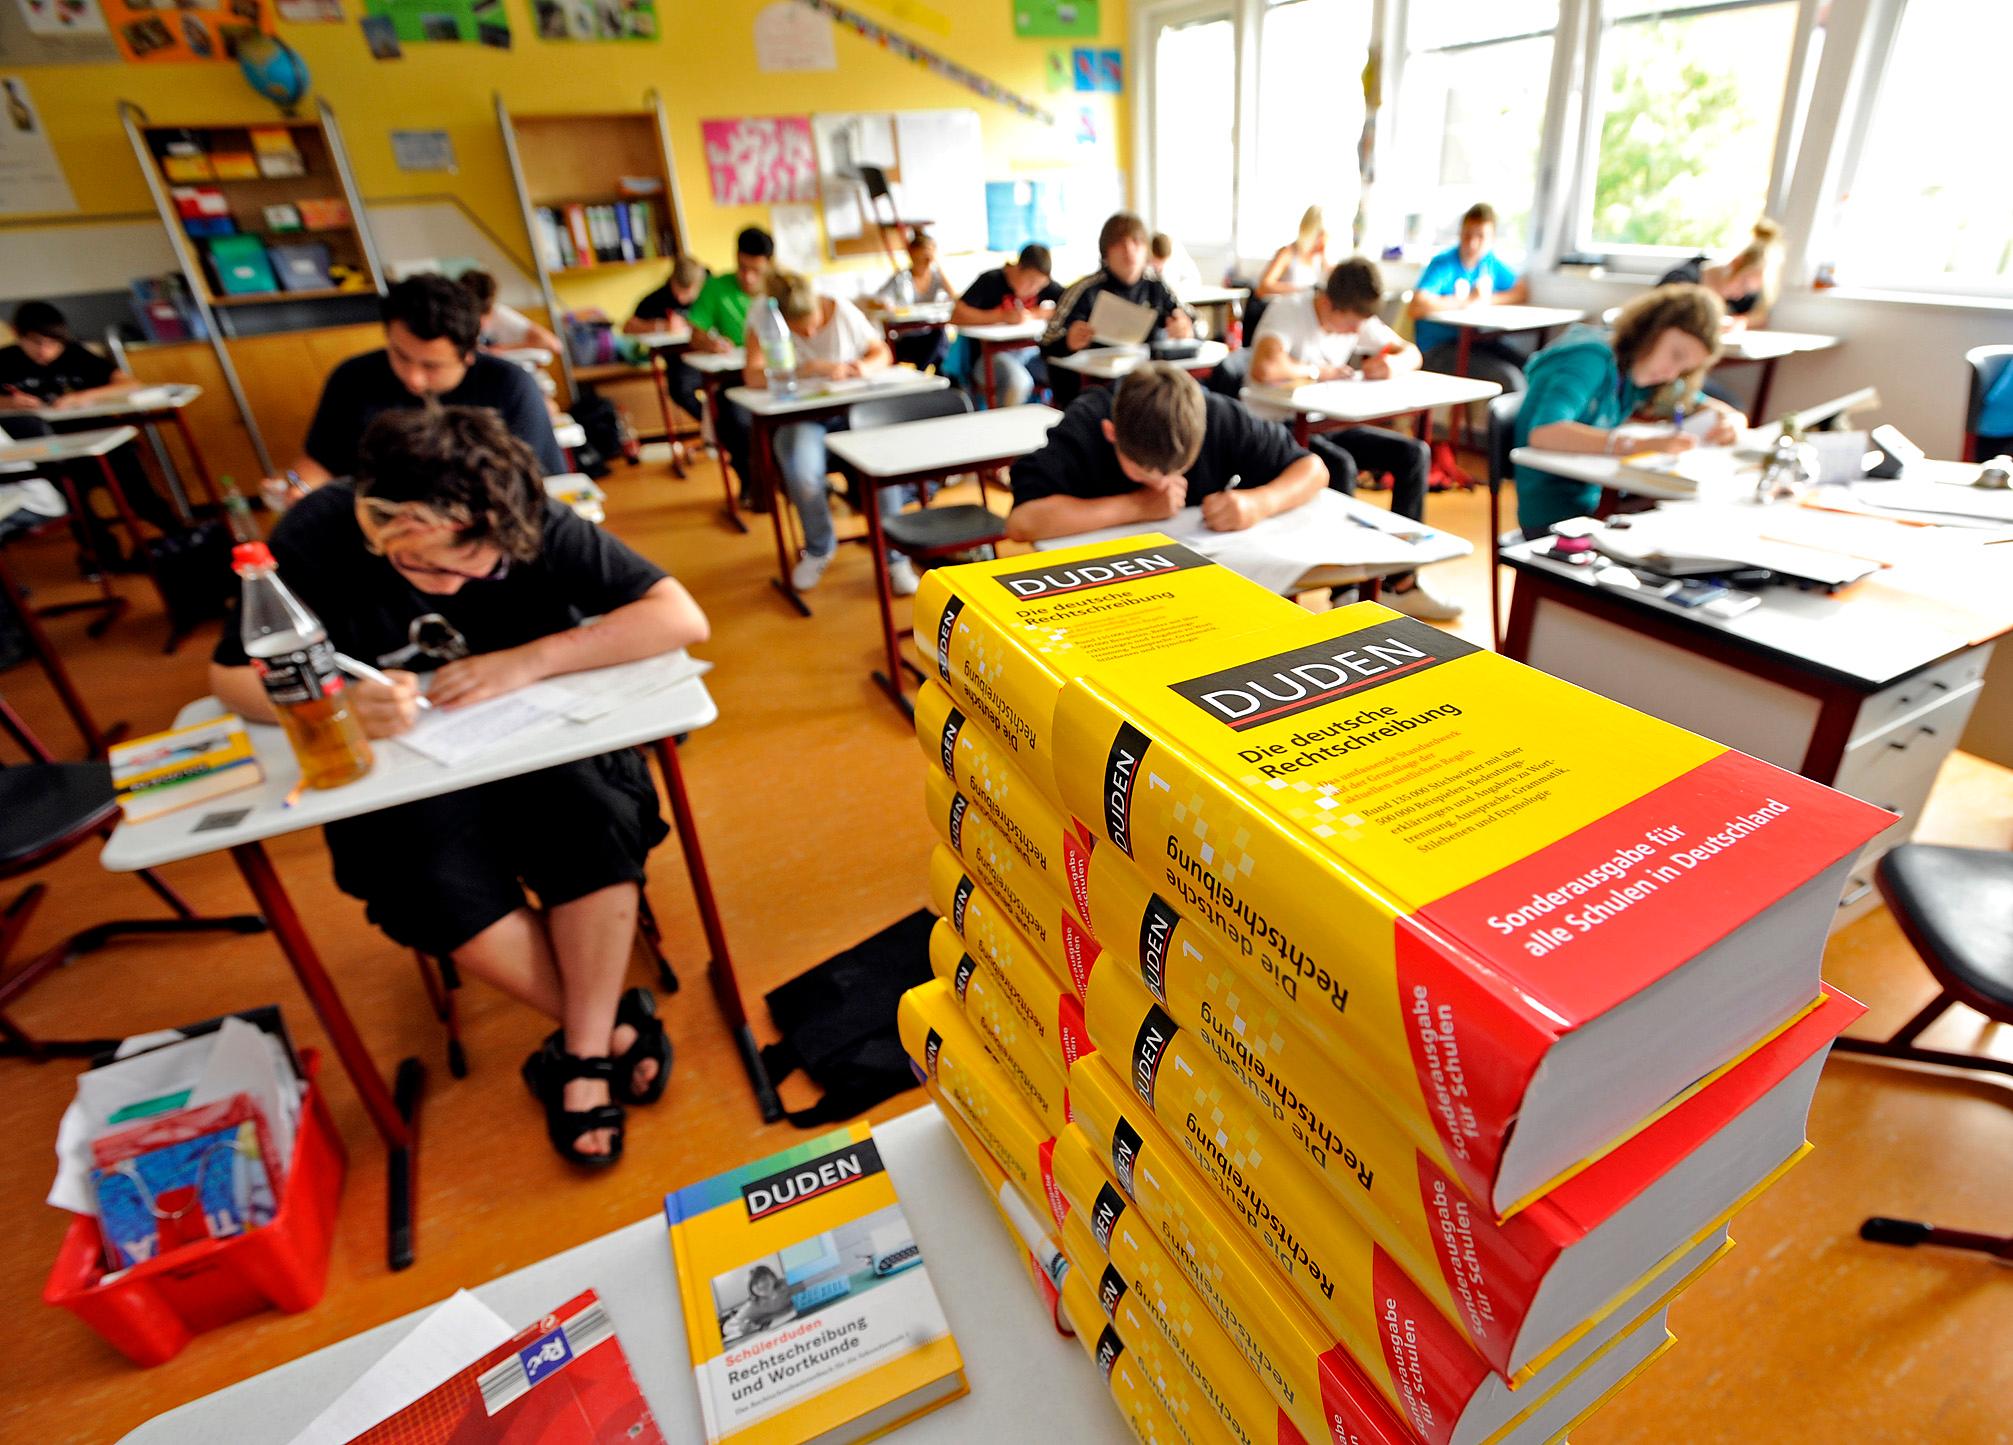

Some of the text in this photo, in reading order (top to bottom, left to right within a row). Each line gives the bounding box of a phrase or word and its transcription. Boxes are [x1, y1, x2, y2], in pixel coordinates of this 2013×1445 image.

[1009, 554, 1176, 596] DUDEN
[1016, 605, 1048, 618] Die
[1053, 589, 1132, 612] deutsche
[1024, 589, 1176, 626] Rechtschreibung
[939, 610, 956, 682] DUDEN
[959, 622, 969, 634] 1
[964, 660, 1036, 750] Rechtschreibung
[1200, 638, 1427, 719] DUDEN
[944, 722, 958, 780] UDEN
[961, 737, 973, 751] 1
[963, 683, 1018, 752] Die deutsche
[1237, 704, 1398, 764] Die deutsche
[1258, 702, 1462, 779] Rechtschreibung
[1110, 748, 1137, 854] DUDEN
[1148, 771, 1171, 793] 1
[1361, 800, 1392, 817] Rund
[1428, 763, 1486, 790] Stichwörter
[1485, 755, 1503, 767] mit
[1500, 747, 1524, 759] über
[1391, 759, 1555, 835] erklärungen und Angaben zu Wort-
[1466, 760, 1525, 787] Bedeutungs-
[970, 775, 1047, 871] Rechtschreibung
[1417, 790, 1551, 854] Stilebenen und Etymologie
[975, 847, 1047, 943] Rechtschreibung
[1487, 824, 1686, 935] Sonderausgabe für
[1523, 797, 1790, 957] alle Schulen in Deutschland
[1166, 834, 1349, 1013] Rechtschreibung
[1166, 868, 1298, 1002] Die deutsche
[1182, 939, 1204, 962] 1
[1174, 1054, 1194, 1078] 1
[1200, 1001, 1374, 1192] Rechtschreibung
[1200, 1027, 1327, 1170] Die deutsche
[1412, 984, 1471, 1160] Sonderausgabe
[1437, 1004, 1480, 1138] für Schulen
[747, 1153, 863, 1215] DUDEN
[1143, 1167, 1160, 1191] 1
[1184, 1135, 1259, 1229] deutsche
[1186, 1112, 1335, 1301] Rechtschreibung
[1123, 1230, 1139, 1251] 1
[1263, 1230, 1295, 1277] Die
[1433, 1180, 1487, 1338] Sonderausgabe
[1456, 1201, 1494, 1322] für Schulen
[725, 1319, 823, 1367] Schülerduden
[1126, 1308, 1140, 1329] 1
[1162, 1221, 1295, 1405] Rechtschreibung
[728, 1316, 868, 1385] Rechtschreibung
[731, 1377, 763, 1401] und
[768, 1337, 860, 1384] Wortkunde
[1121, 1370, 1135, 1390] 1
[1384, 1298, 1429, 1440] Sonderausgabe
[1403, 1319, 1435, 1427] für Schulen
